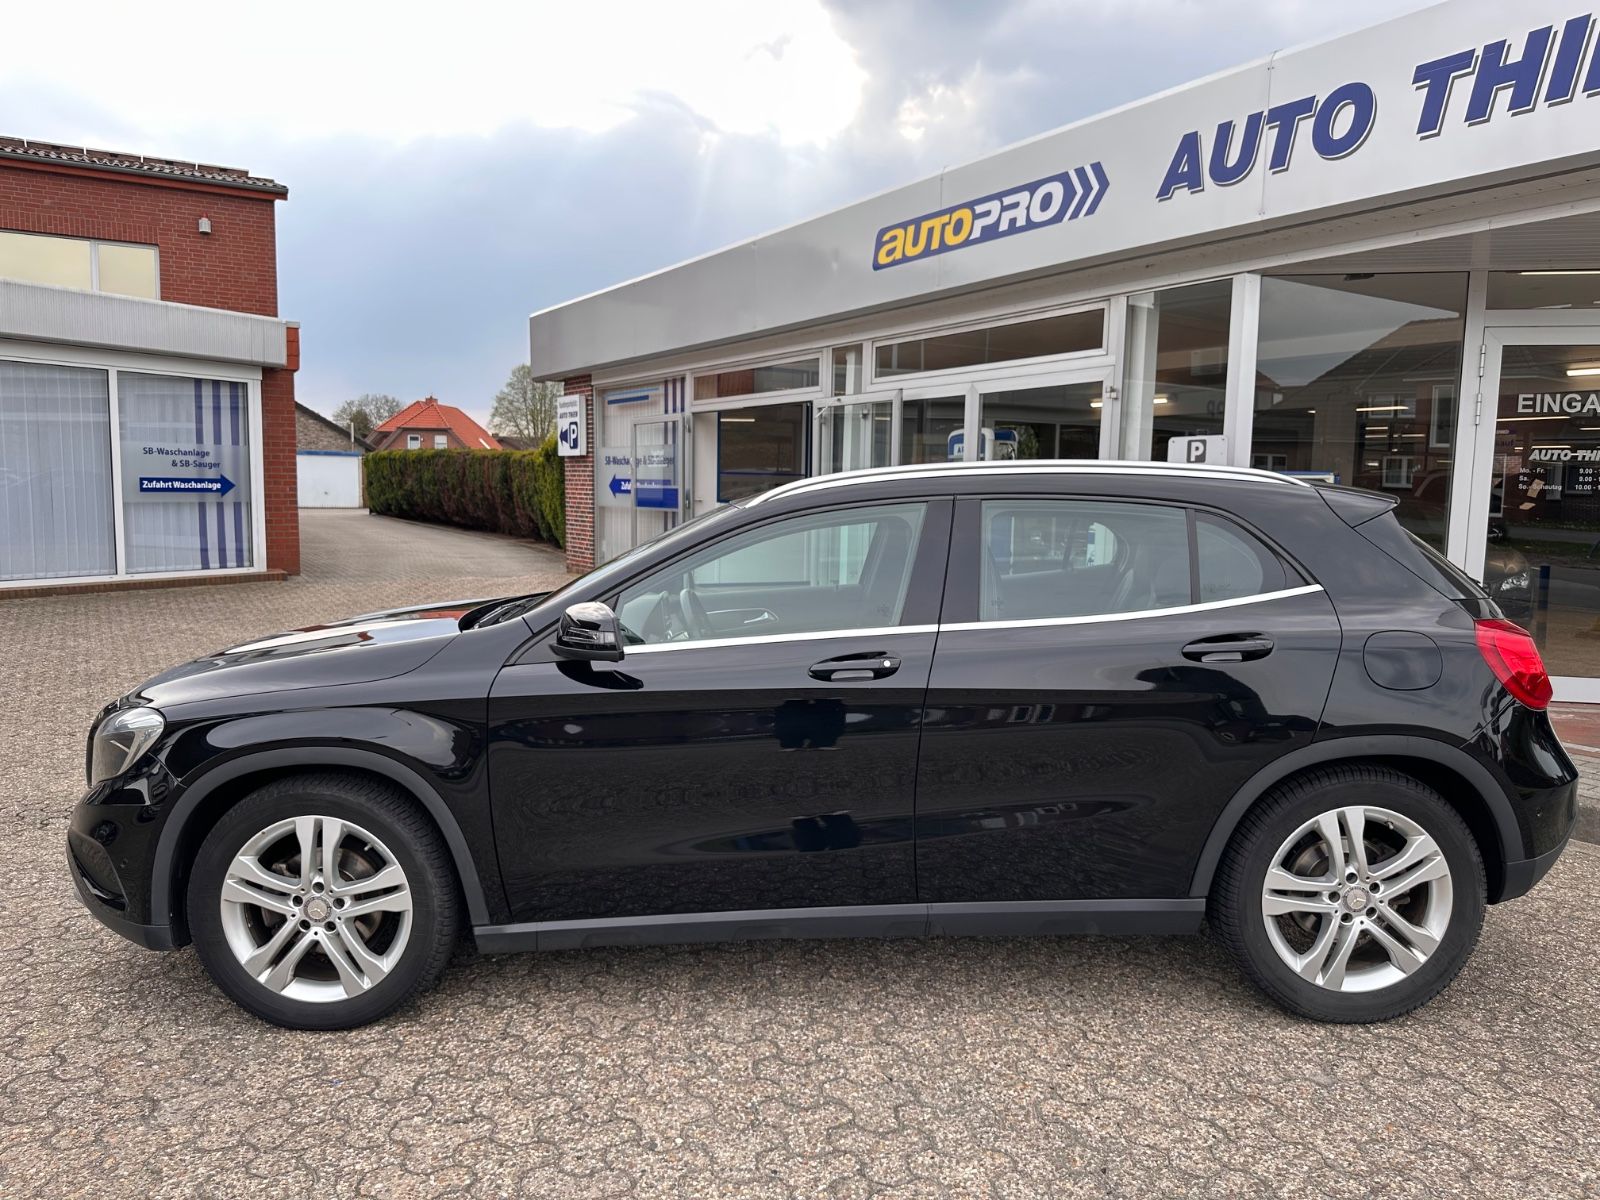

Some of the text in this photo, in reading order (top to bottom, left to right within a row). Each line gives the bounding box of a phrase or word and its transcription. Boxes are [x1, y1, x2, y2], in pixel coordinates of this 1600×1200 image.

[1156, 82, 1376, 201] AUTO
[1517, 393, 1600, 413] EINGA
[570, 424, 577, 448] P
[142, 447, 210, 458] SB-Waschanlage
[1190, 441, 1204, 462] P
[1528, 449, 1571, 461] AUTO
[179, 459, 221, 470] SB-Sauger
[142, 480, 222, 491] Zufahrt Waschanlage
